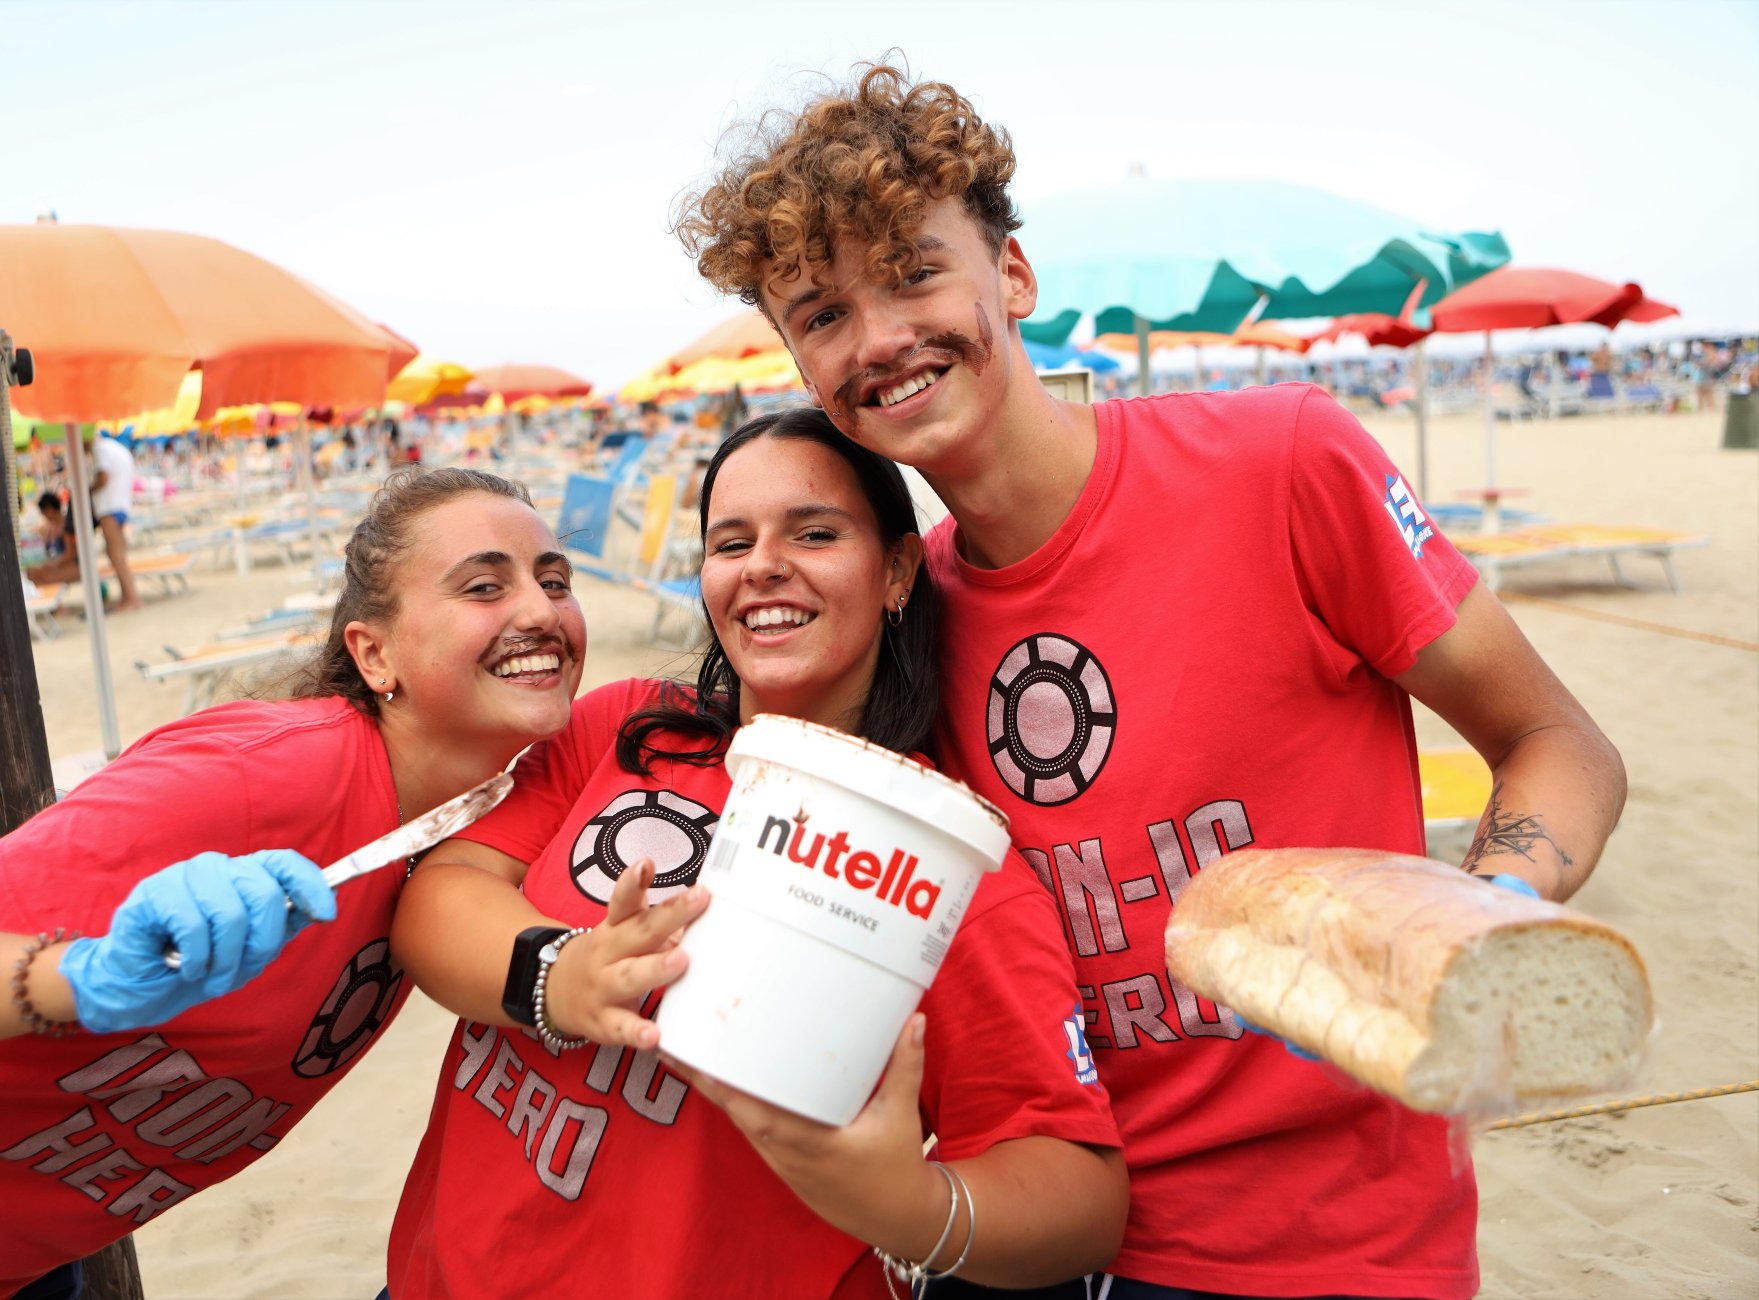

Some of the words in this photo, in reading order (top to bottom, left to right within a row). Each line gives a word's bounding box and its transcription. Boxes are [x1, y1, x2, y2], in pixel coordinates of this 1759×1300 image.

[756, 814, 942, 921] nutella
[787, 884, 825, 908] FOOD
[828, 901, 880, 932] SERVICE
